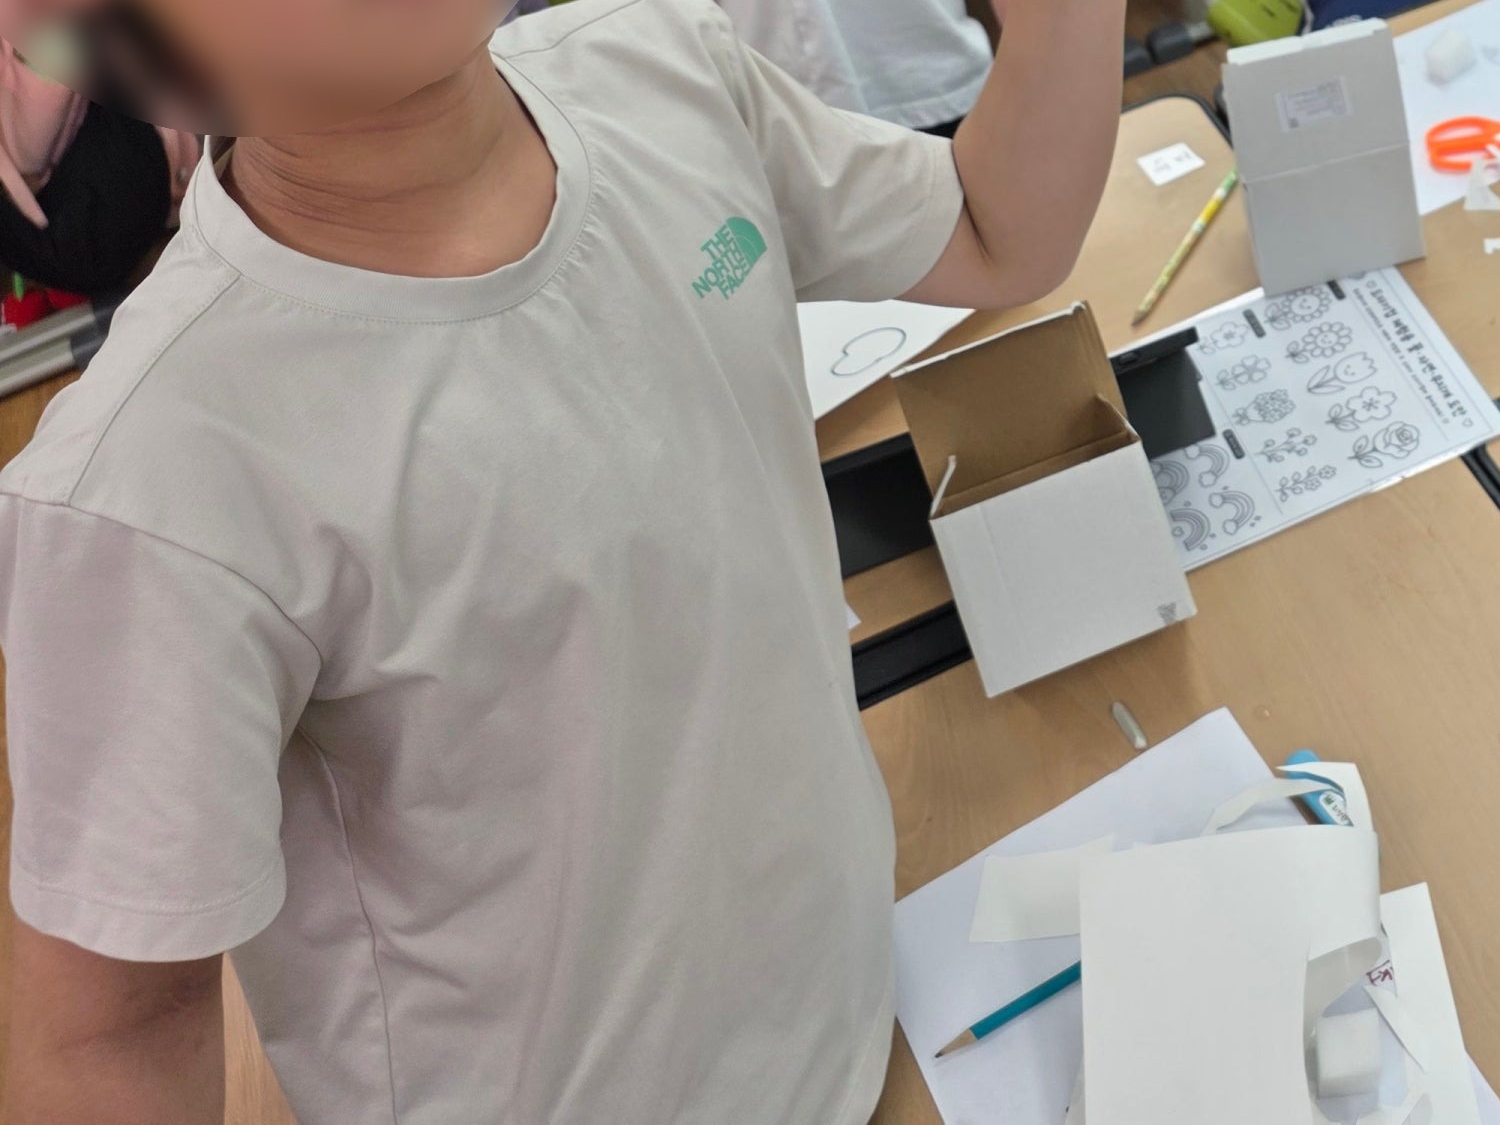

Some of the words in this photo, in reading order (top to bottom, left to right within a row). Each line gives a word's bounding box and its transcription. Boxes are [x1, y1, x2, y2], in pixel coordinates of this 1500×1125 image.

[700, 224, 735, 261] THE
[691, 240, 746, 300] NORTH
[716, 263, 751, 301] FACE
